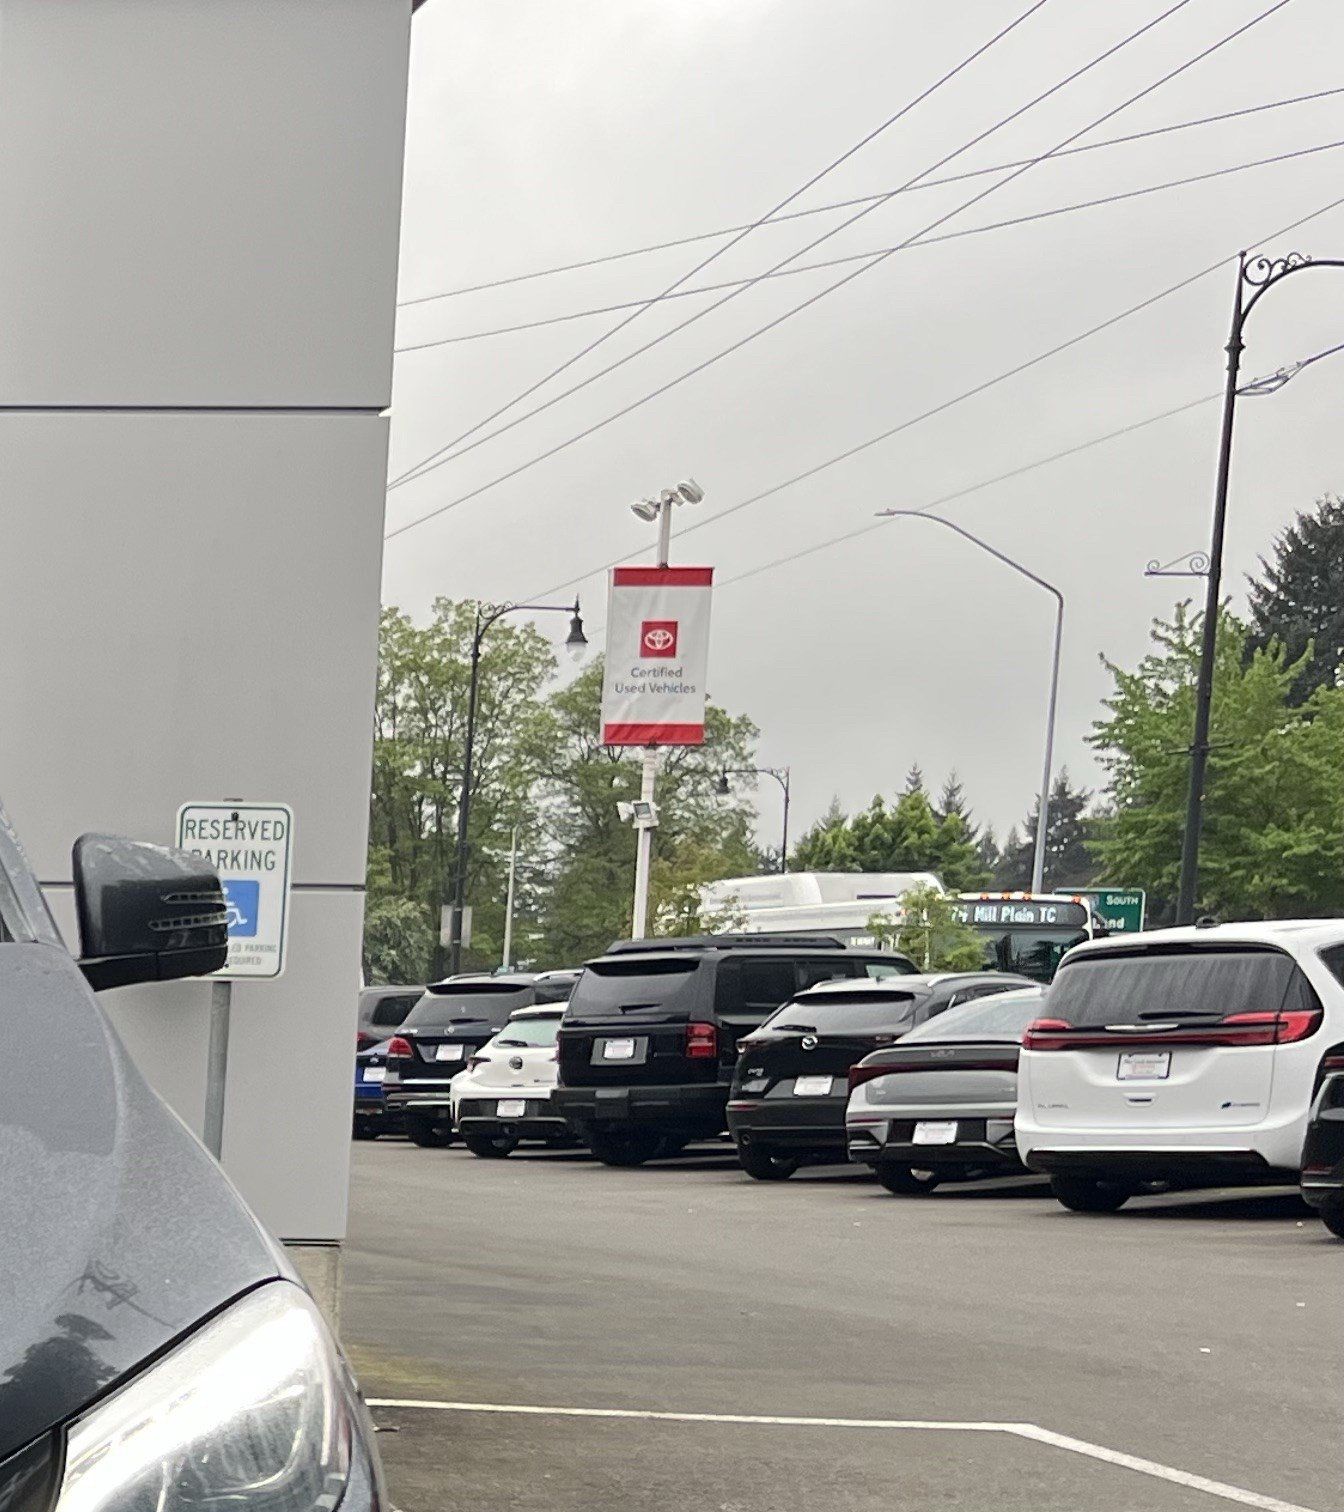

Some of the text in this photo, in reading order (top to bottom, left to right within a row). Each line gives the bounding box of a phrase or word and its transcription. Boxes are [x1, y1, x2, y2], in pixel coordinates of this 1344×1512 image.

[630, 666, 683, 679] Certified
[614, 682, 696, 694] Used Vehicles
[185, 819, 285, 841] RESERVED
[974, 905, 998, 922] Mill
[1000, 906, 1034, 923] Plain
[1039, 907, 1057, 923] TC
